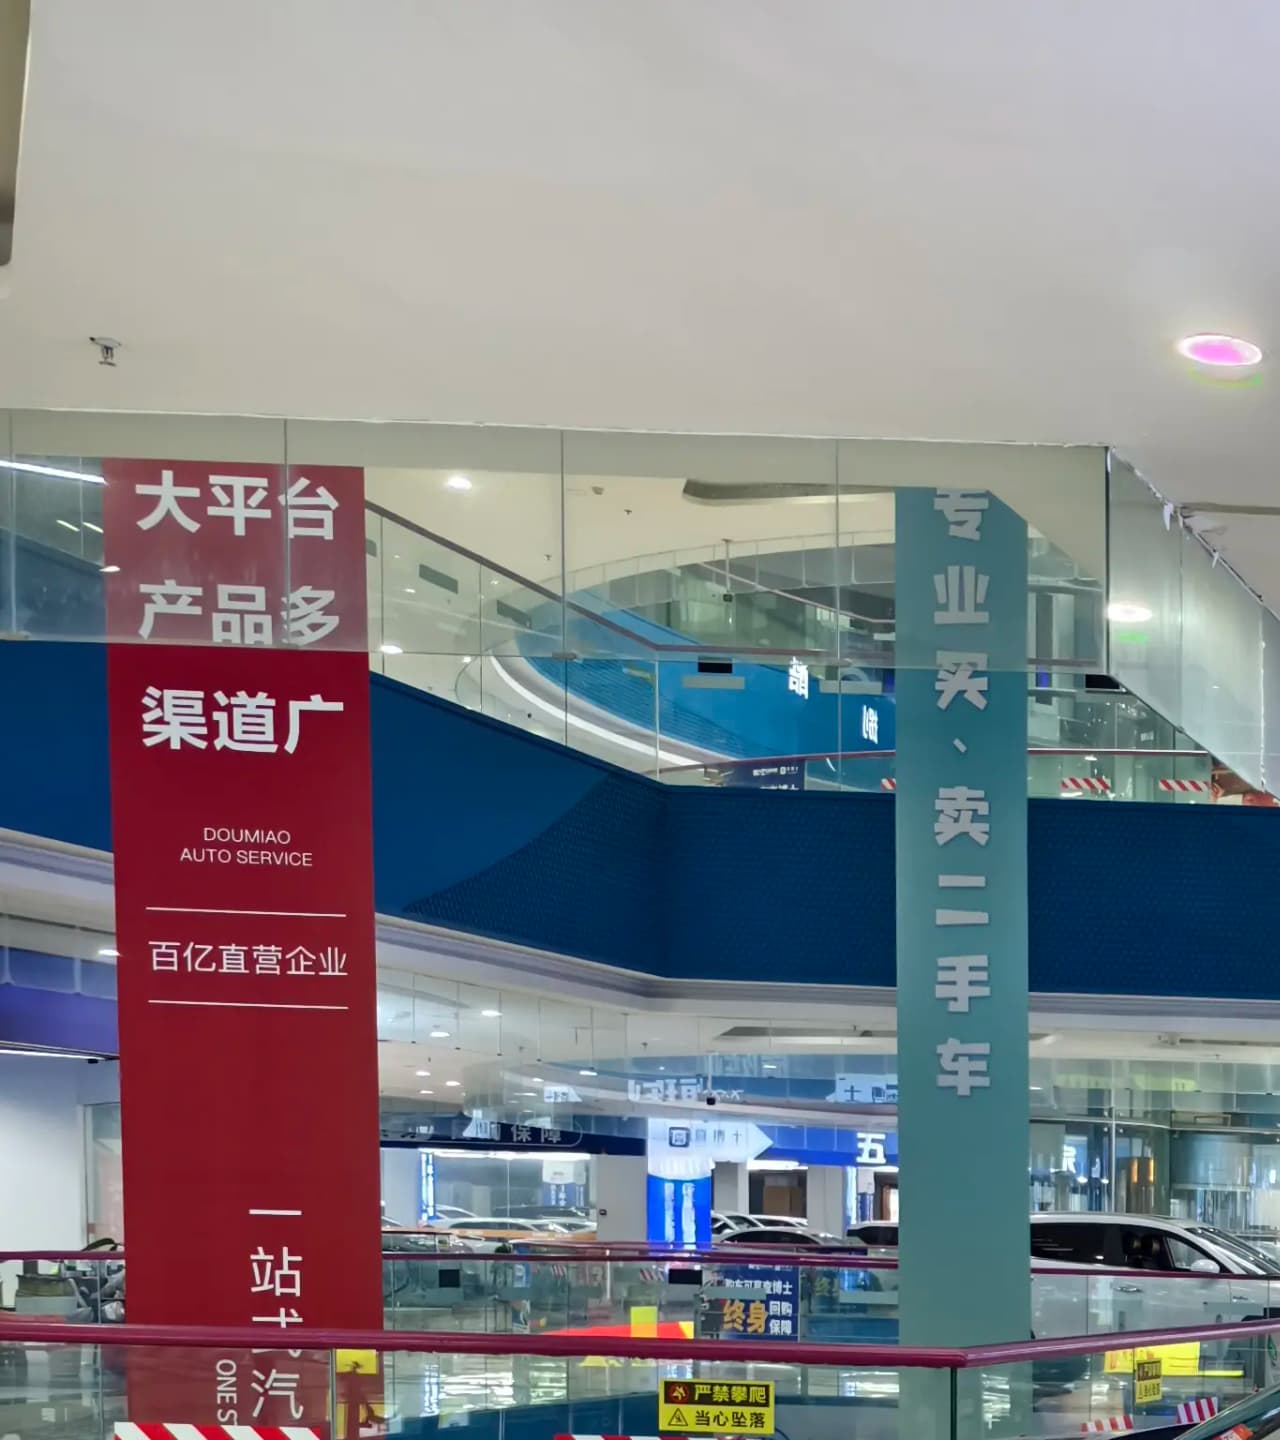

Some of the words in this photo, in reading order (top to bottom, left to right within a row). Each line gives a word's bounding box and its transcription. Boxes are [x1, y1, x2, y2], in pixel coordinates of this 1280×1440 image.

[135, 470, 340, 540] 大平台
[138, 579, 340, 647] 产品多
[141, 686, 345, 755] 渠道广
[933, 489, 991, 1096] 专业买、卖二手车
[203, 827, 291, 845] DOUMIAO
[180, 847, 231, 865] AUTO
[236, 848, 313, 867] SERVICE
[147, 940, 349, 976] 百亿直营企业
[215, 1359, 238, 1405] ONE
[694, 1384, 768, 1404] 严禁攀爬
[694, 1410, 766, 1429] 当心坠落
